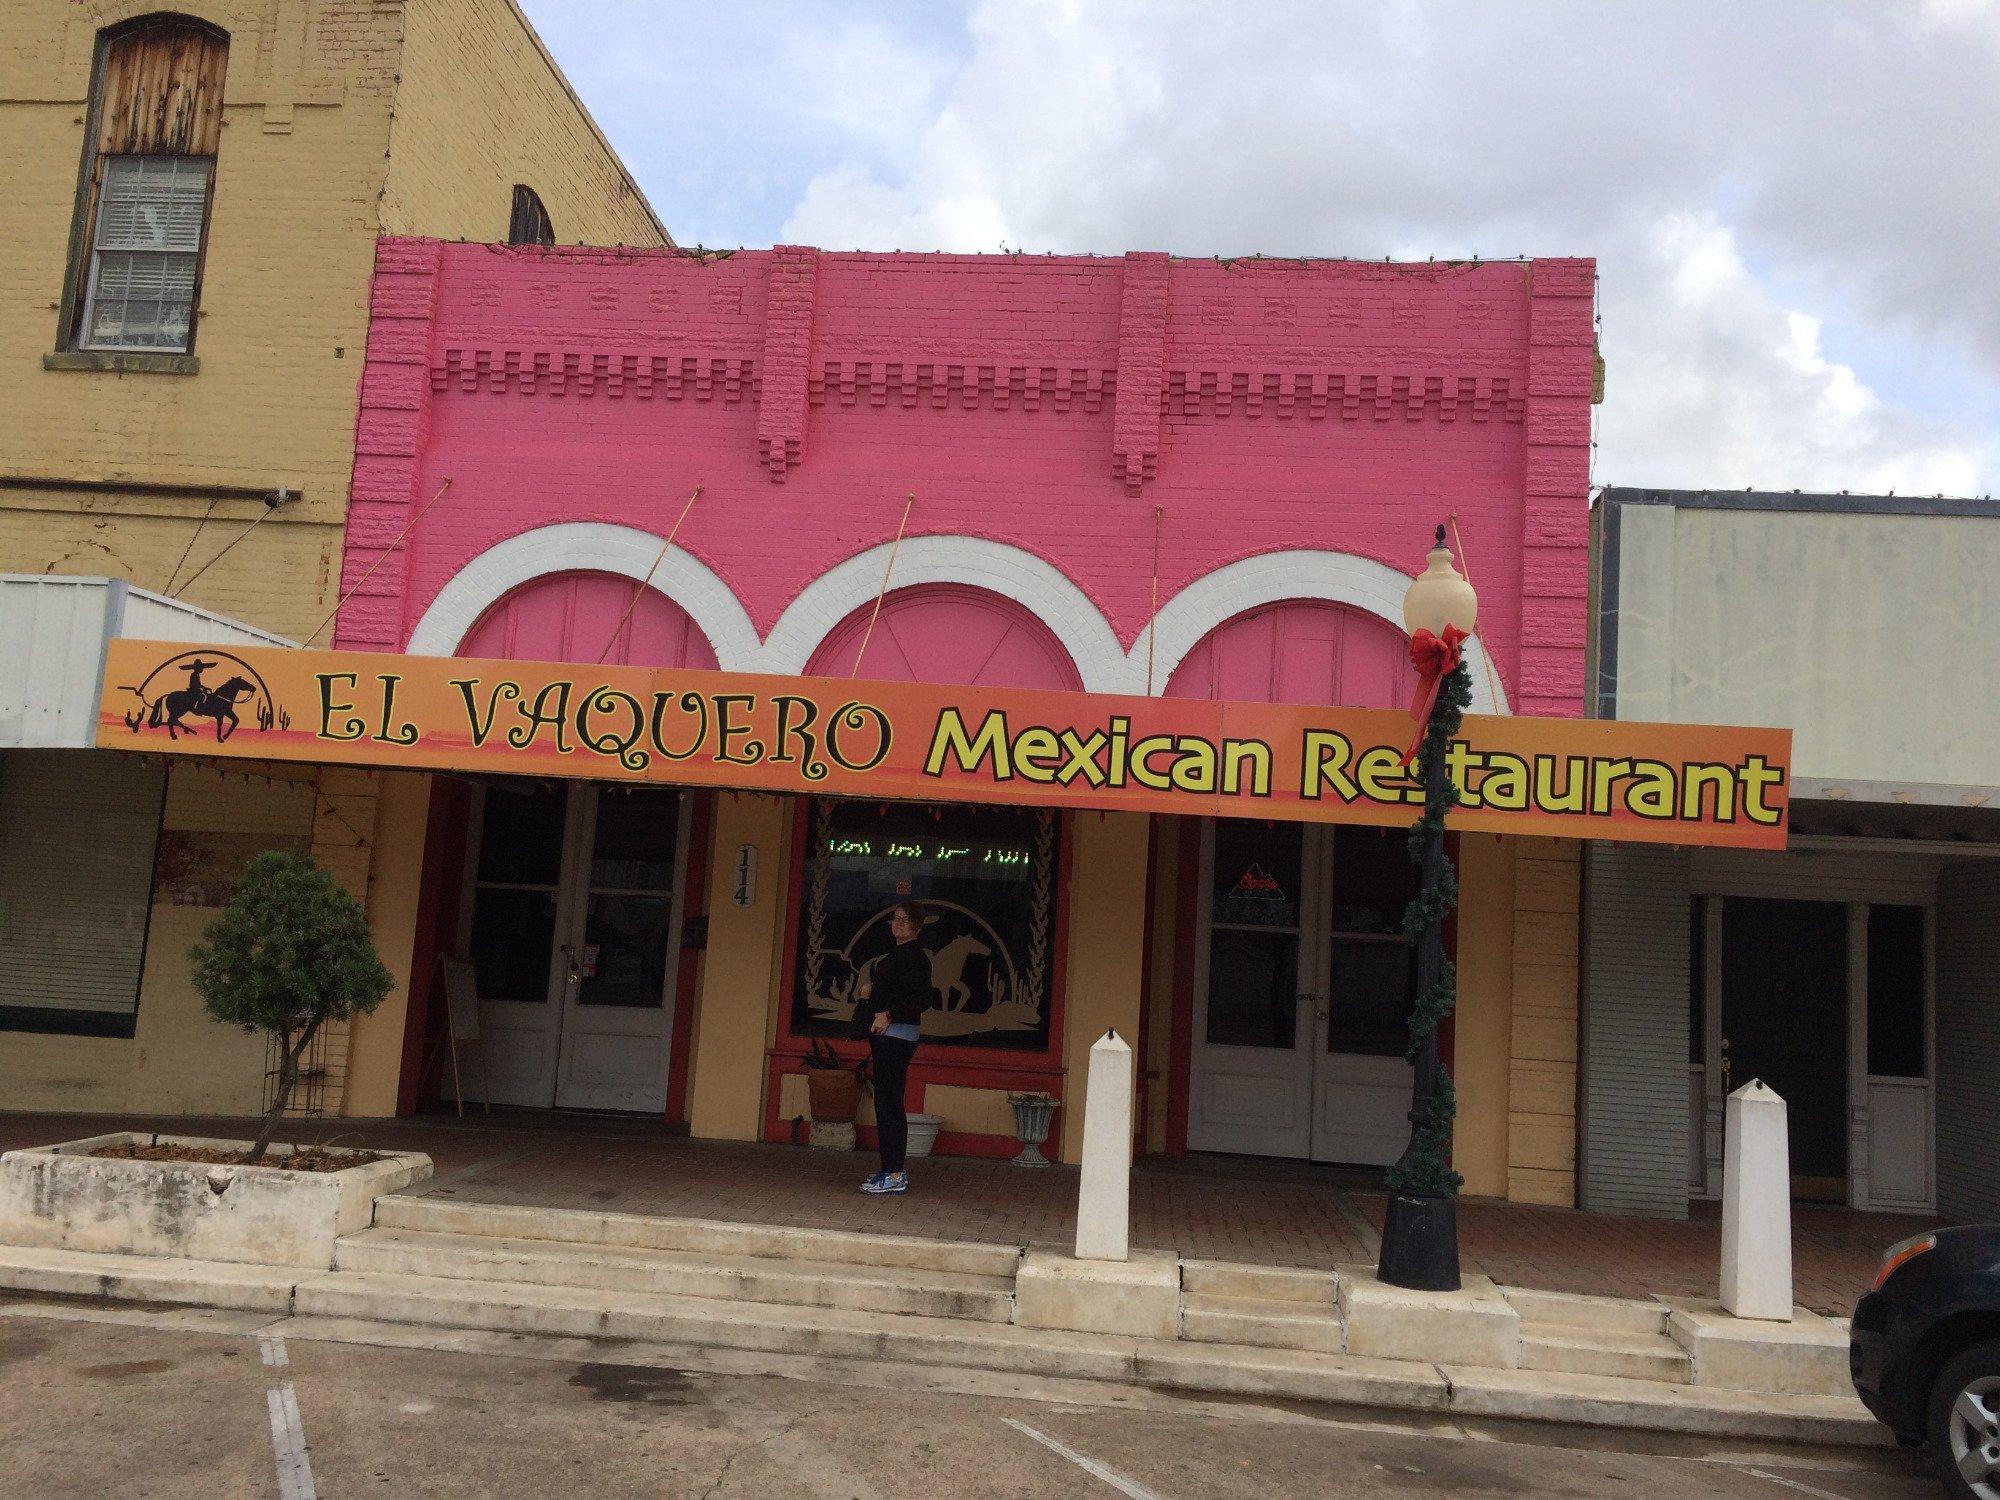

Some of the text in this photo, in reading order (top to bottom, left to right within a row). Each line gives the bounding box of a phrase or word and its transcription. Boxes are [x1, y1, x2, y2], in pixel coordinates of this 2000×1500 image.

[315, 672, 419, 747] EL
[448, 678, 893, 781] VAQUERO
[922, 706, 1274, 798] Mexican
[734, 848, 751, 906] 114
